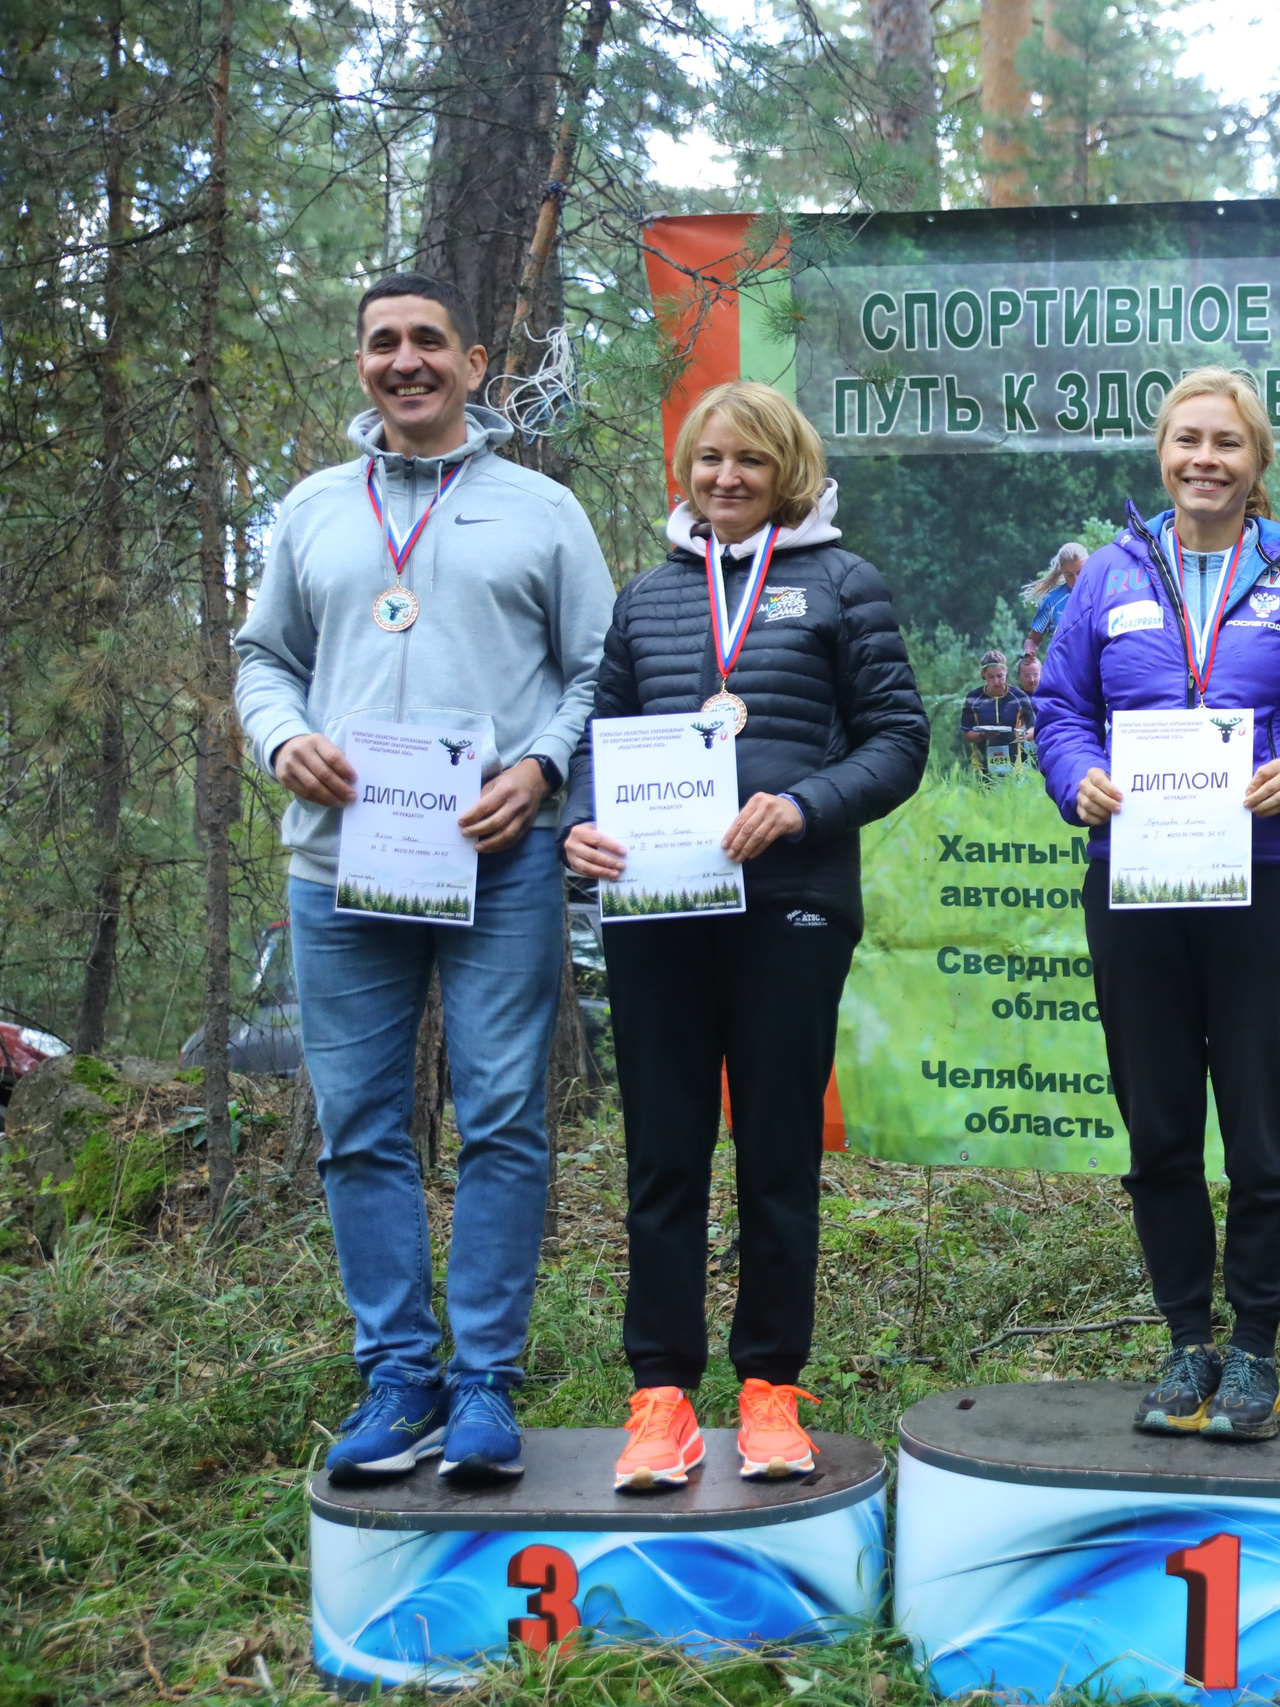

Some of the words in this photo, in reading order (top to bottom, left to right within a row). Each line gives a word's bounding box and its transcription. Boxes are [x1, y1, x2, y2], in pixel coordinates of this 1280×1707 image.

[861, 283, 1270, 352] СПОРТИВНОЕ
[833, 373, 983, 436] ПУТЬ
[1004, 373, 1038, 433] К
[363, 785, 457, 811] ДИПЛОМ
[616, 779, 715, 804] ДИПЛОМ
[1131, 771, 1229, 792] ДИПЛОМ
[937, 946, 1094, 982] Свердло
[992, 991, 1101, 1023] облас
[921, 1060, 1115, 1095] Челябинс
[964, 1105, 1115, 1139] область
[508, 1543, 581, 1660] 3
[1165, 1531, 1242, 1690] 1
